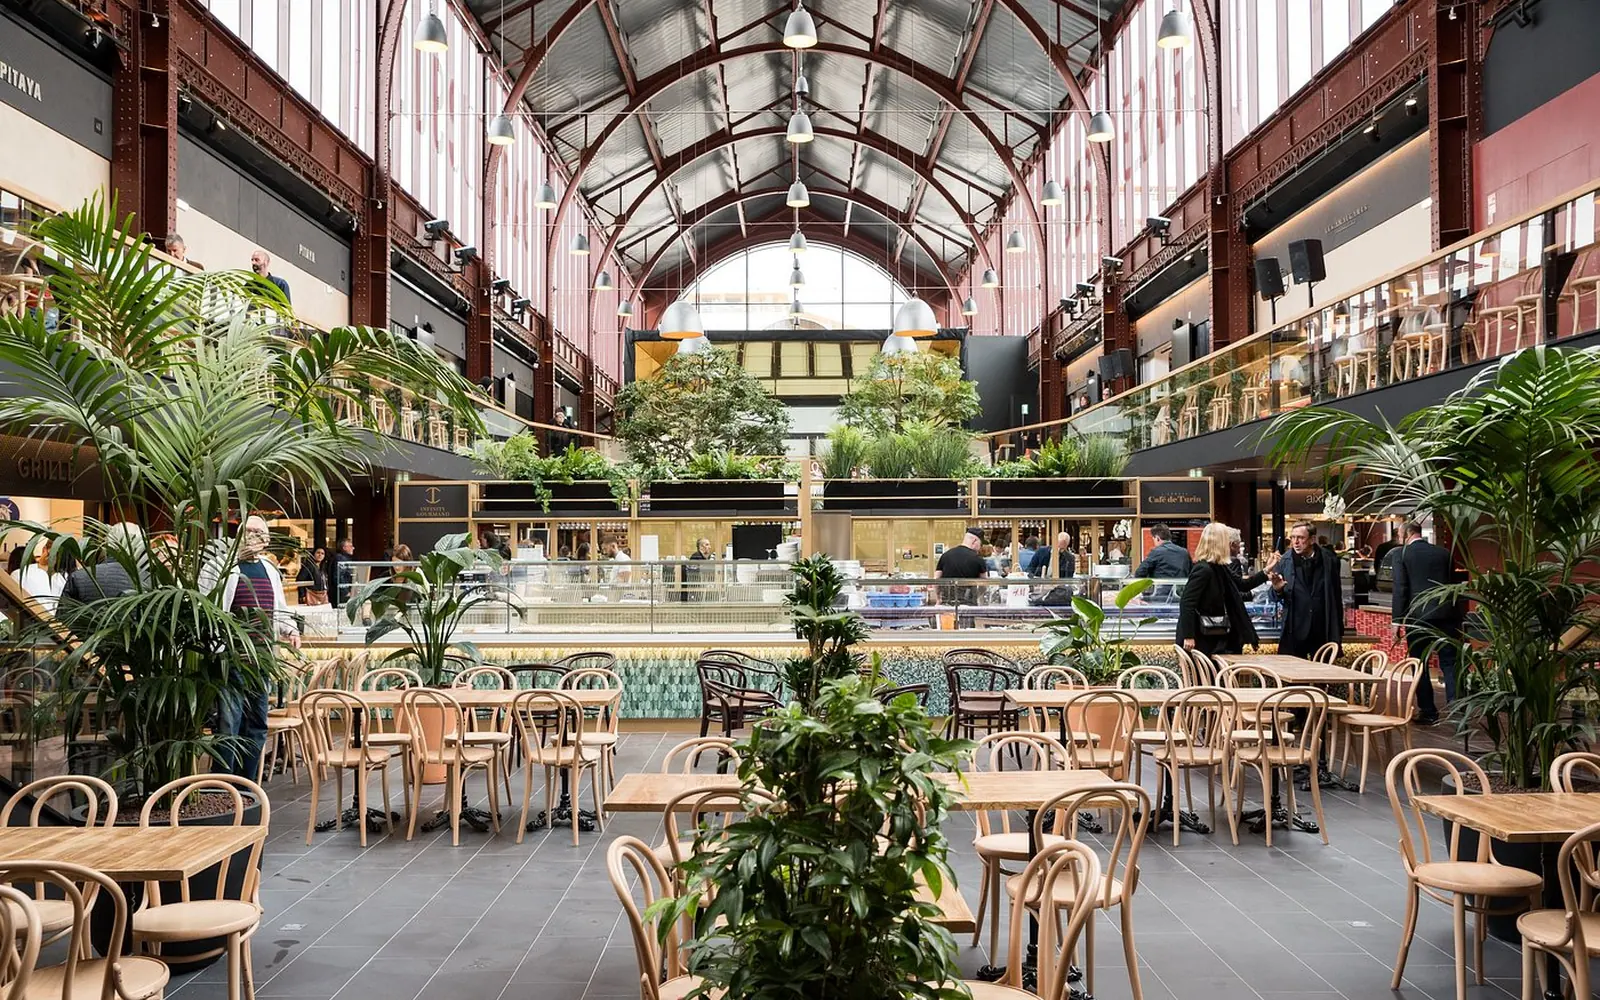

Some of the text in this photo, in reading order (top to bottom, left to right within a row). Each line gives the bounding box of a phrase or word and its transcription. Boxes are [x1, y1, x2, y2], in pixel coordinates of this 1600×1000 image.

[0, 61, 42, 102] PITAYA
[1148, 495, 1202, 503] Café de Turin
